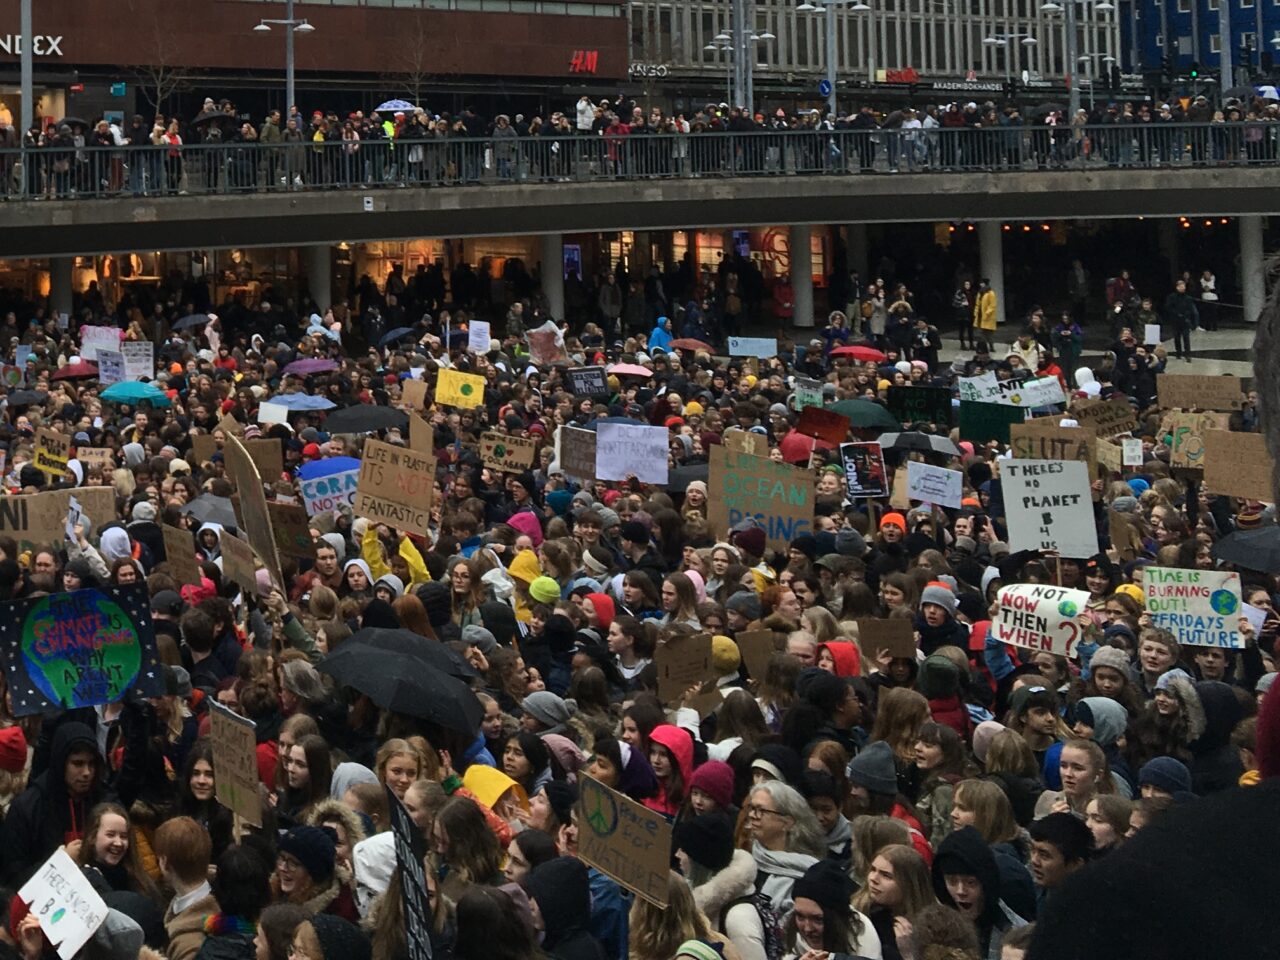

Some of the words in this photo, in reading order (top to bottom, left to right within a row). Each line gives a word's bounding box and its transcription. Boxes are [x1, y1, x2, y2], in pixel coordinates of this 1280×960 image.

[569, 50, 598, 74] H&M
[366, 446, 387, 462] LIFE
[390, 453, 400, 464] IN
[404, 455, 433, 473] PLASTIC
[396, 473, 432, 496] NOT
[722, 472, 807, 506] OCEAN
[1025, 479, 1040, 488] NO
[1022, 494, 1080, 509] PLANET
[361, 496, 423, 527] FANTASTIC
[1042, 512, 1053, 525] B
[1040, 526, 1050, 536] 4
[1041, 541, 1058, 550] US
[1188, 569, 1200, 582] IS
[1032, 587, 1068, 602] NOT
[1148, 586, 1211, 598] BURNING
[1001, 593, 1041, 613] NOW
[1149, 598, 1188, 612] OUT!
[1001, 608, 1048, 633] THEN
[1179, 628, 1240, 647] FUTURE
[42, 862, 70, 896] THERE
[39, 897, 56, 915] B
